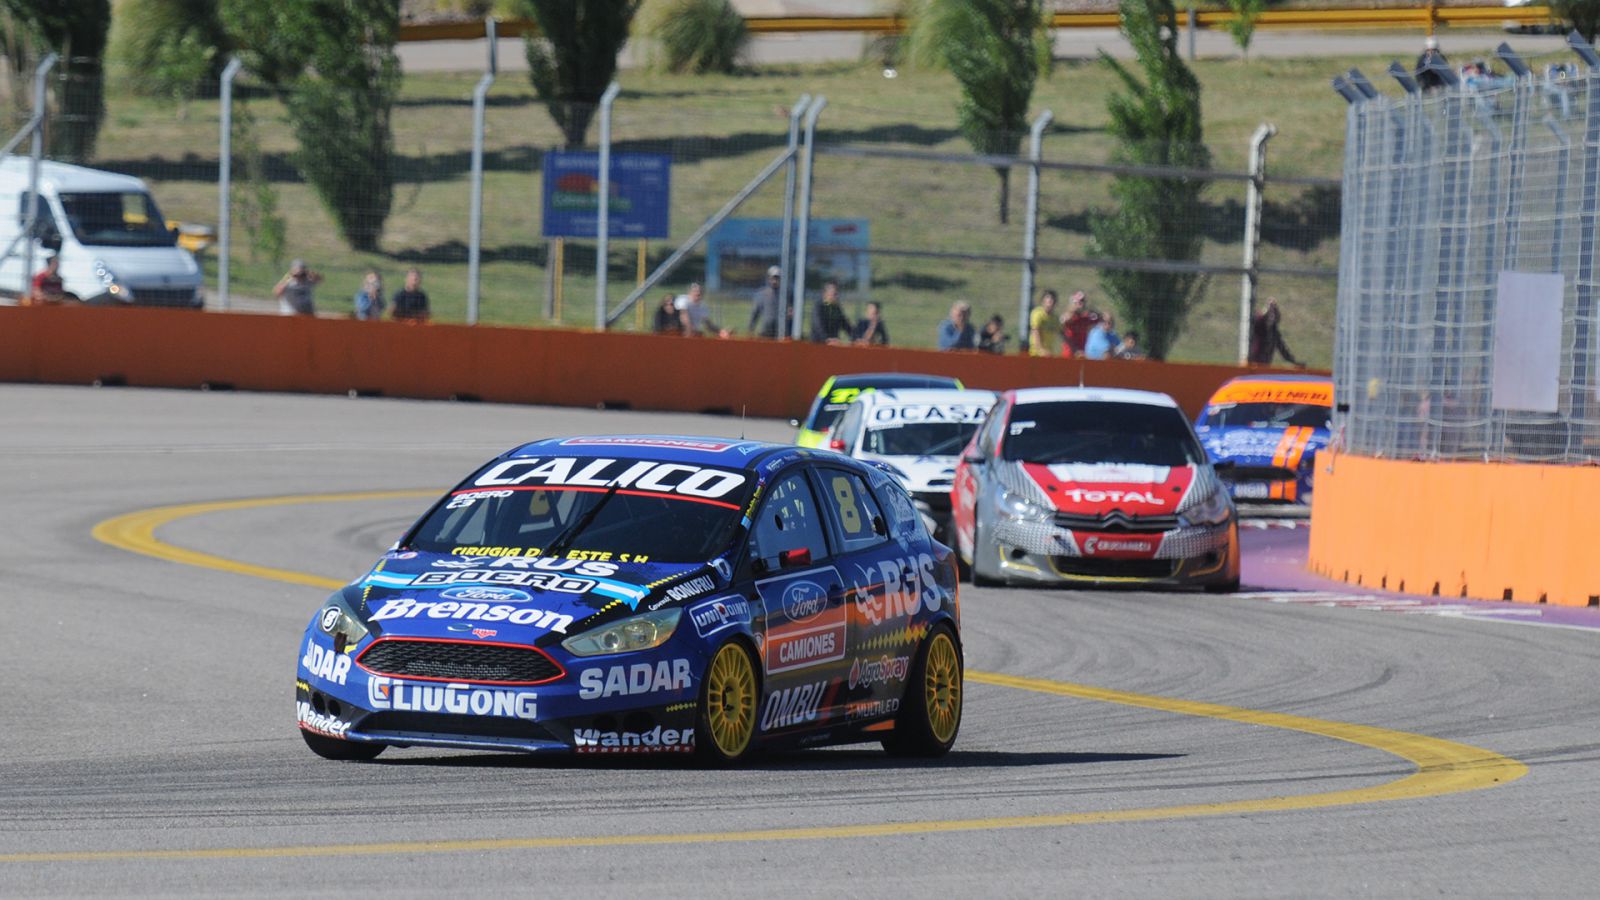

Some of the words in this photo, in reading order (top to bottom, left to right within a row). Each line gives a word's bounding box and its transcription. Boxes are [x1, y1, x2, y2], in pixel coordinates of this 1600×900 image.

[474, 457, 746, 498] CALICO
[831, 476, 861, 534] 8
[1064, 488, 1165, 505] TOTAL
[451, 546, 521, 558] CIRUGIA
[567, 549, 611, 562] ESTE
[488, 554, 619, 577] RUS
[410, 571, 598, 594] BOERO
[879, 553, 942, 619] RUS
[369, 599, 573, 633] Brenson
[790, 586, 821, 617] Ford
[302, 638, 351, 686] SADAR
[779, 632, 836, 664] CAMIONES
[578, 658, 692, 701] SADAR
[393, 679, 538, 719] LIUGONG
[760, 680, 828, 732] OMBU
[855, 698, 900, 718] MULTILED
[296, 701, 352, 735] Wander
[573, 725, 695, 747] Wander
